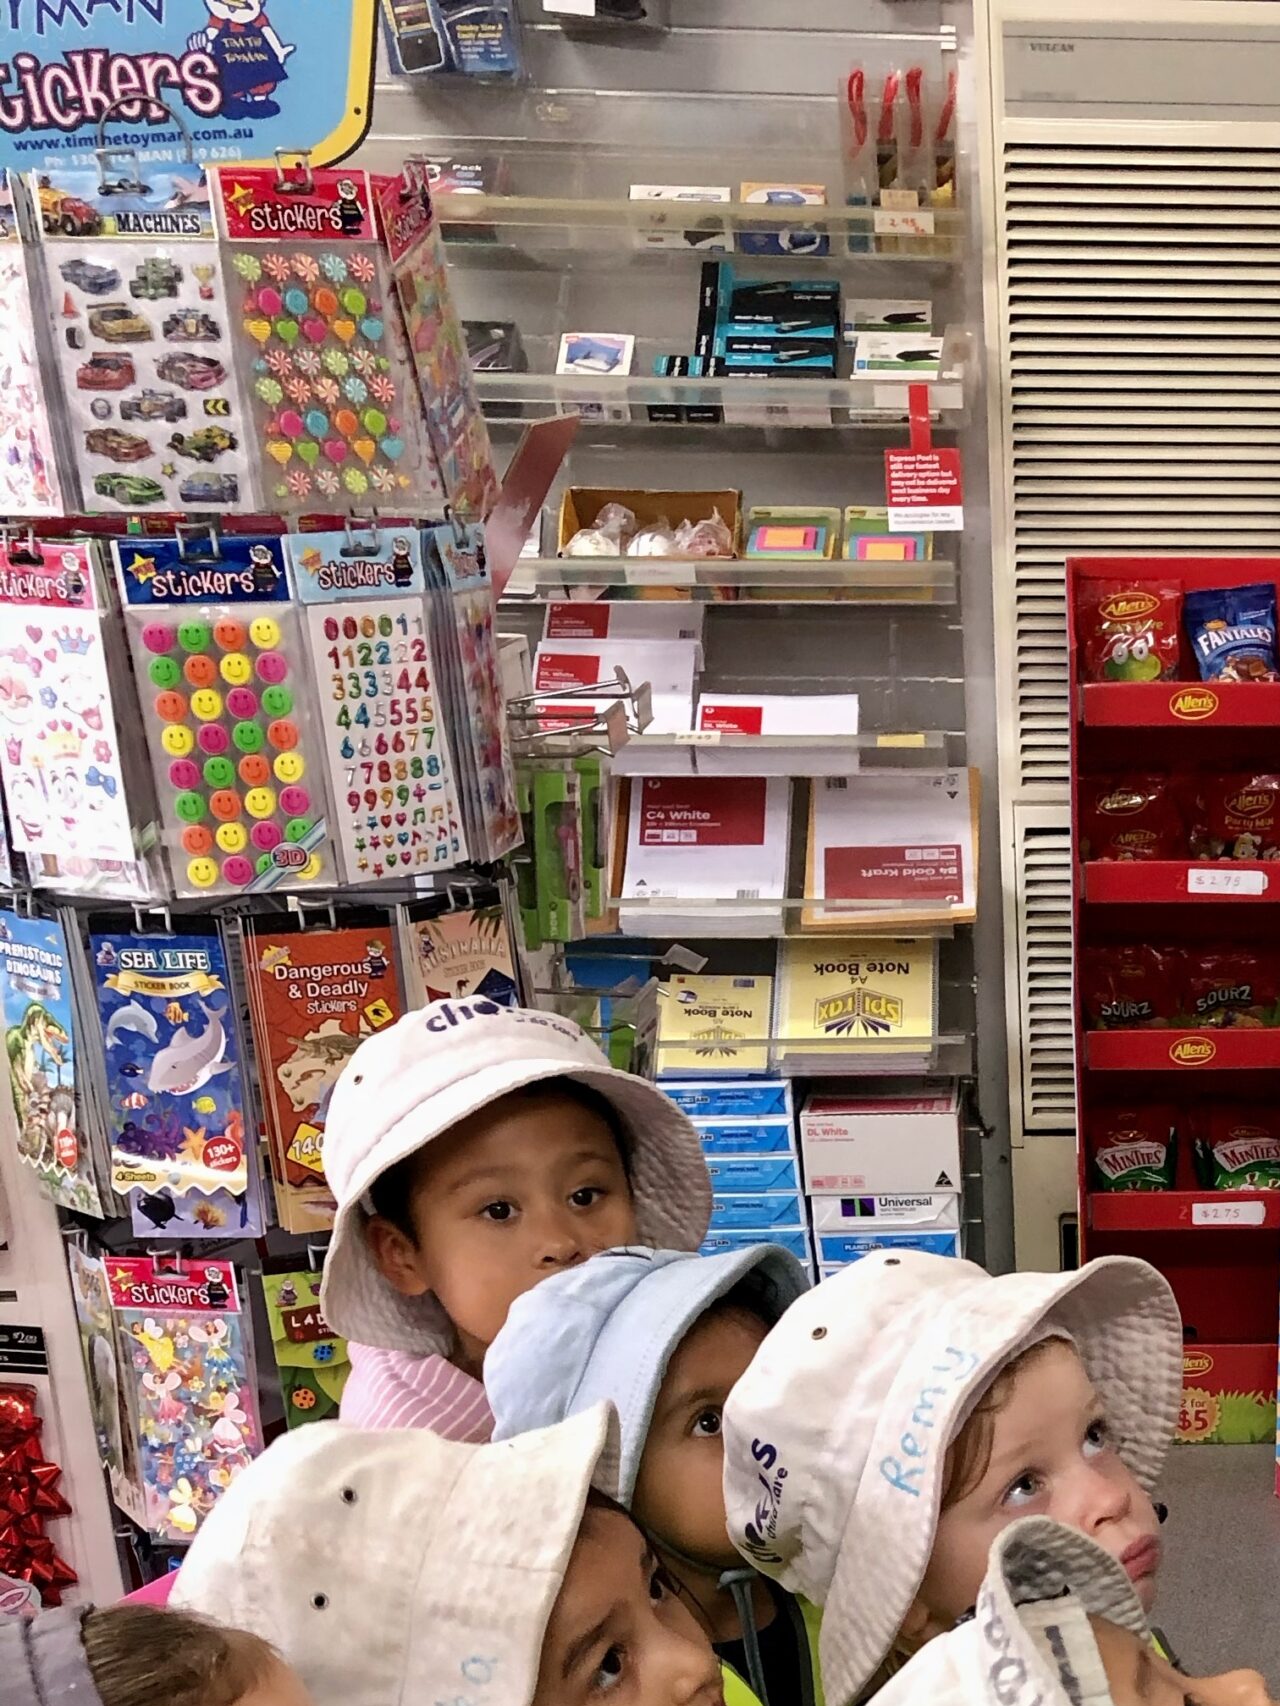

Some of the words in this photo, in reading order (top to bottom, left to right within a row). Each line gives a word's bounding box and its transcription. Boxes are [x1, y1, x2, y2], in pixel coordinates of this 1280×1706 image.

[1029, 43, 1075, 53] VULCAN
[115, 211, 202, 235] MACHINES
[249, 202, 344, 233] stickers
[317, 560, 396, 590] stickers
[151, 570, 255, 598] stickers
[1104, 597, 1156, 616] Allen's
[1196, 626, 1273, 656] FANTALES
[1174, 695, 1214, 712] Allen's
[646, 810, 665, 820] C4
[669, 810, 712, 820] White
[1224, 815, 1251, 828] Party
[273, 846, 308, 870] 3D
[860, 868, 898, 878] Kraft
[898, 867, 936, 877] Gold
[0, 940, 63, 969] PREHISTORIC
[120, 951, 157, 970] SEA
[163, 951, 210, 971] LIFE
[419, 936, 506, 978] AUSTRALIA
[7, 959, 62, 986] DINOSAURS
[274, 961, 372, 982] Dangerous
[813, 962, 860, 976] Book
[866, 961, 911, 976] Note
[133, 980, 167, 991] STICKER
[168, 980, 192, 990] BOOK
[849, 975, 869, 985] A4
[288, 984, 302, 999] &
[306, 980, 369, 999] Deadly
[306, 999, 358, 1015] stickers
[1195, 985, 1252, 1012] SOURZ
[684, 1007, 718, 1018] Book
[721, 1008, 753, 1019] Note
[816, 992, 900, 1024] Spirax
[1100, 1001, 1152, 1018] SOURZ
[1174, 1042, 1213, 1059] Allen's
[806, 1128, 820, 1137] DL
[821, 1127, 849, 1137] White
[205, 1143, 236, 1159] 130+
[1222, 1144, 1280, 1169] MINTIES
[1103, 1149, 1162, 1175] MINTIES
[115, 1172, 123, 1182] 4
[124, 1171, 157, 1183] Sheets
[878, 1196, 933, 1208] Universal
[130, 1282, 210, 1305] stickers
[1183, 1356, 1210, 1370] llen's
[1180, 1398, 1187, 1408] 2
[1190, 1398, 1206, 1408] for
[878, 1345, 981, 1498] Remy
[1177, 1409, 1209, 1431] $5
